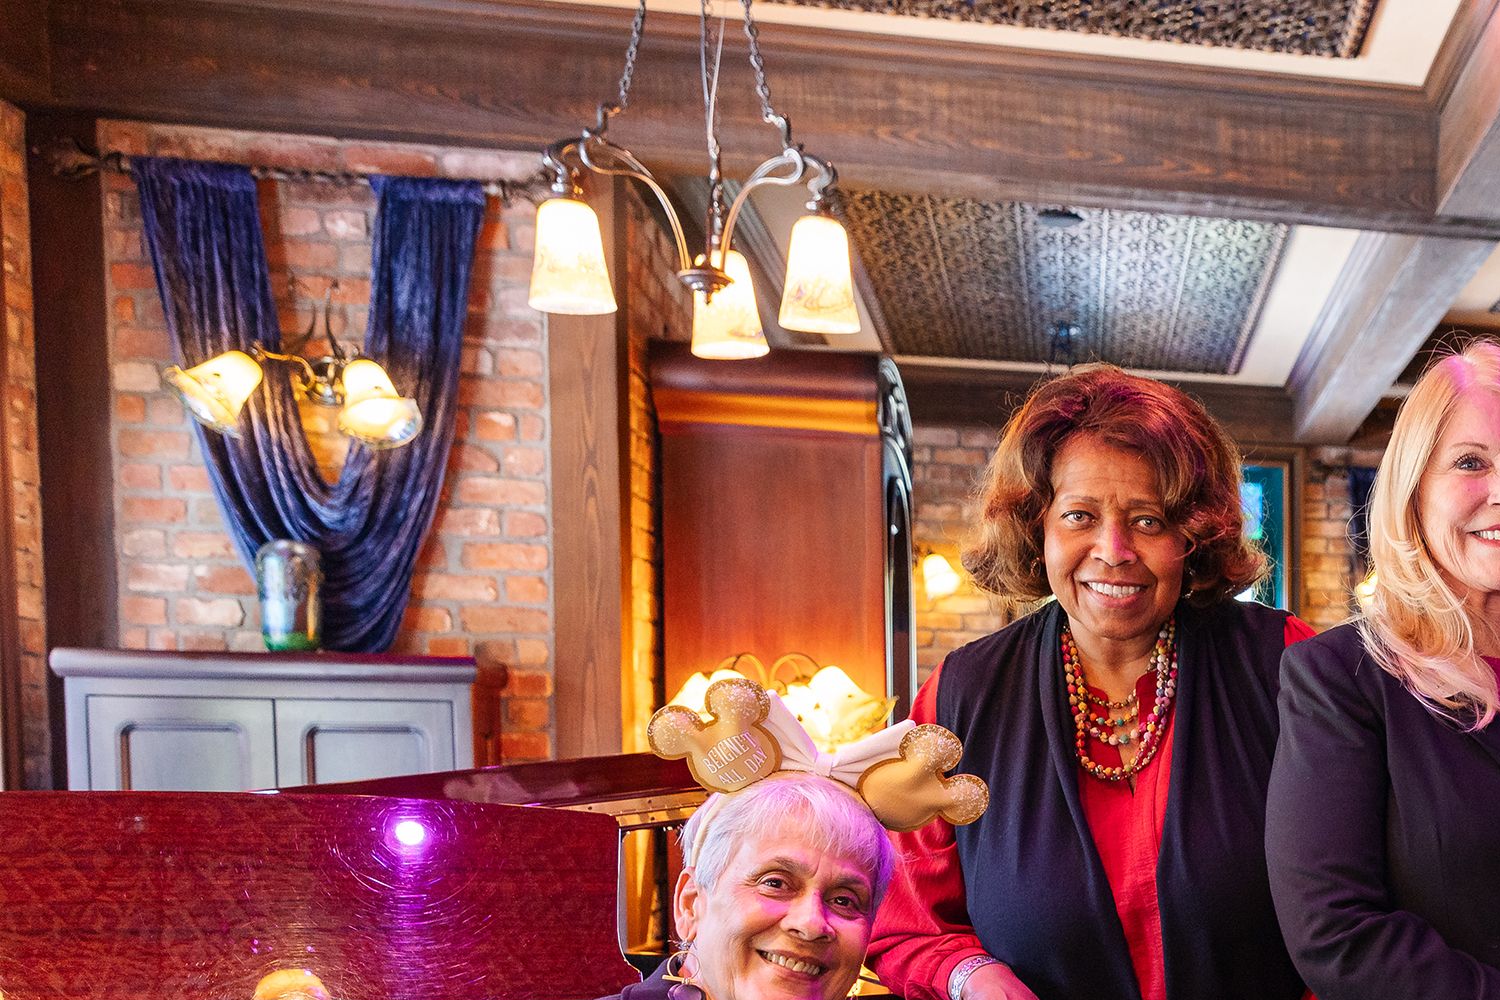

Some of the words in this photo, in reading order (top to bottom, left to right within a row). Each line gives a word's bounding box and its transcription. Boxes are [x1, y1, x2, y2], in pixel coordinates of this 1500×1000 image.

[703, 731, 756, 774] BEIGNET
[719, 769, 747, 785] ALL
[744, 747, 768, 773] DAY
